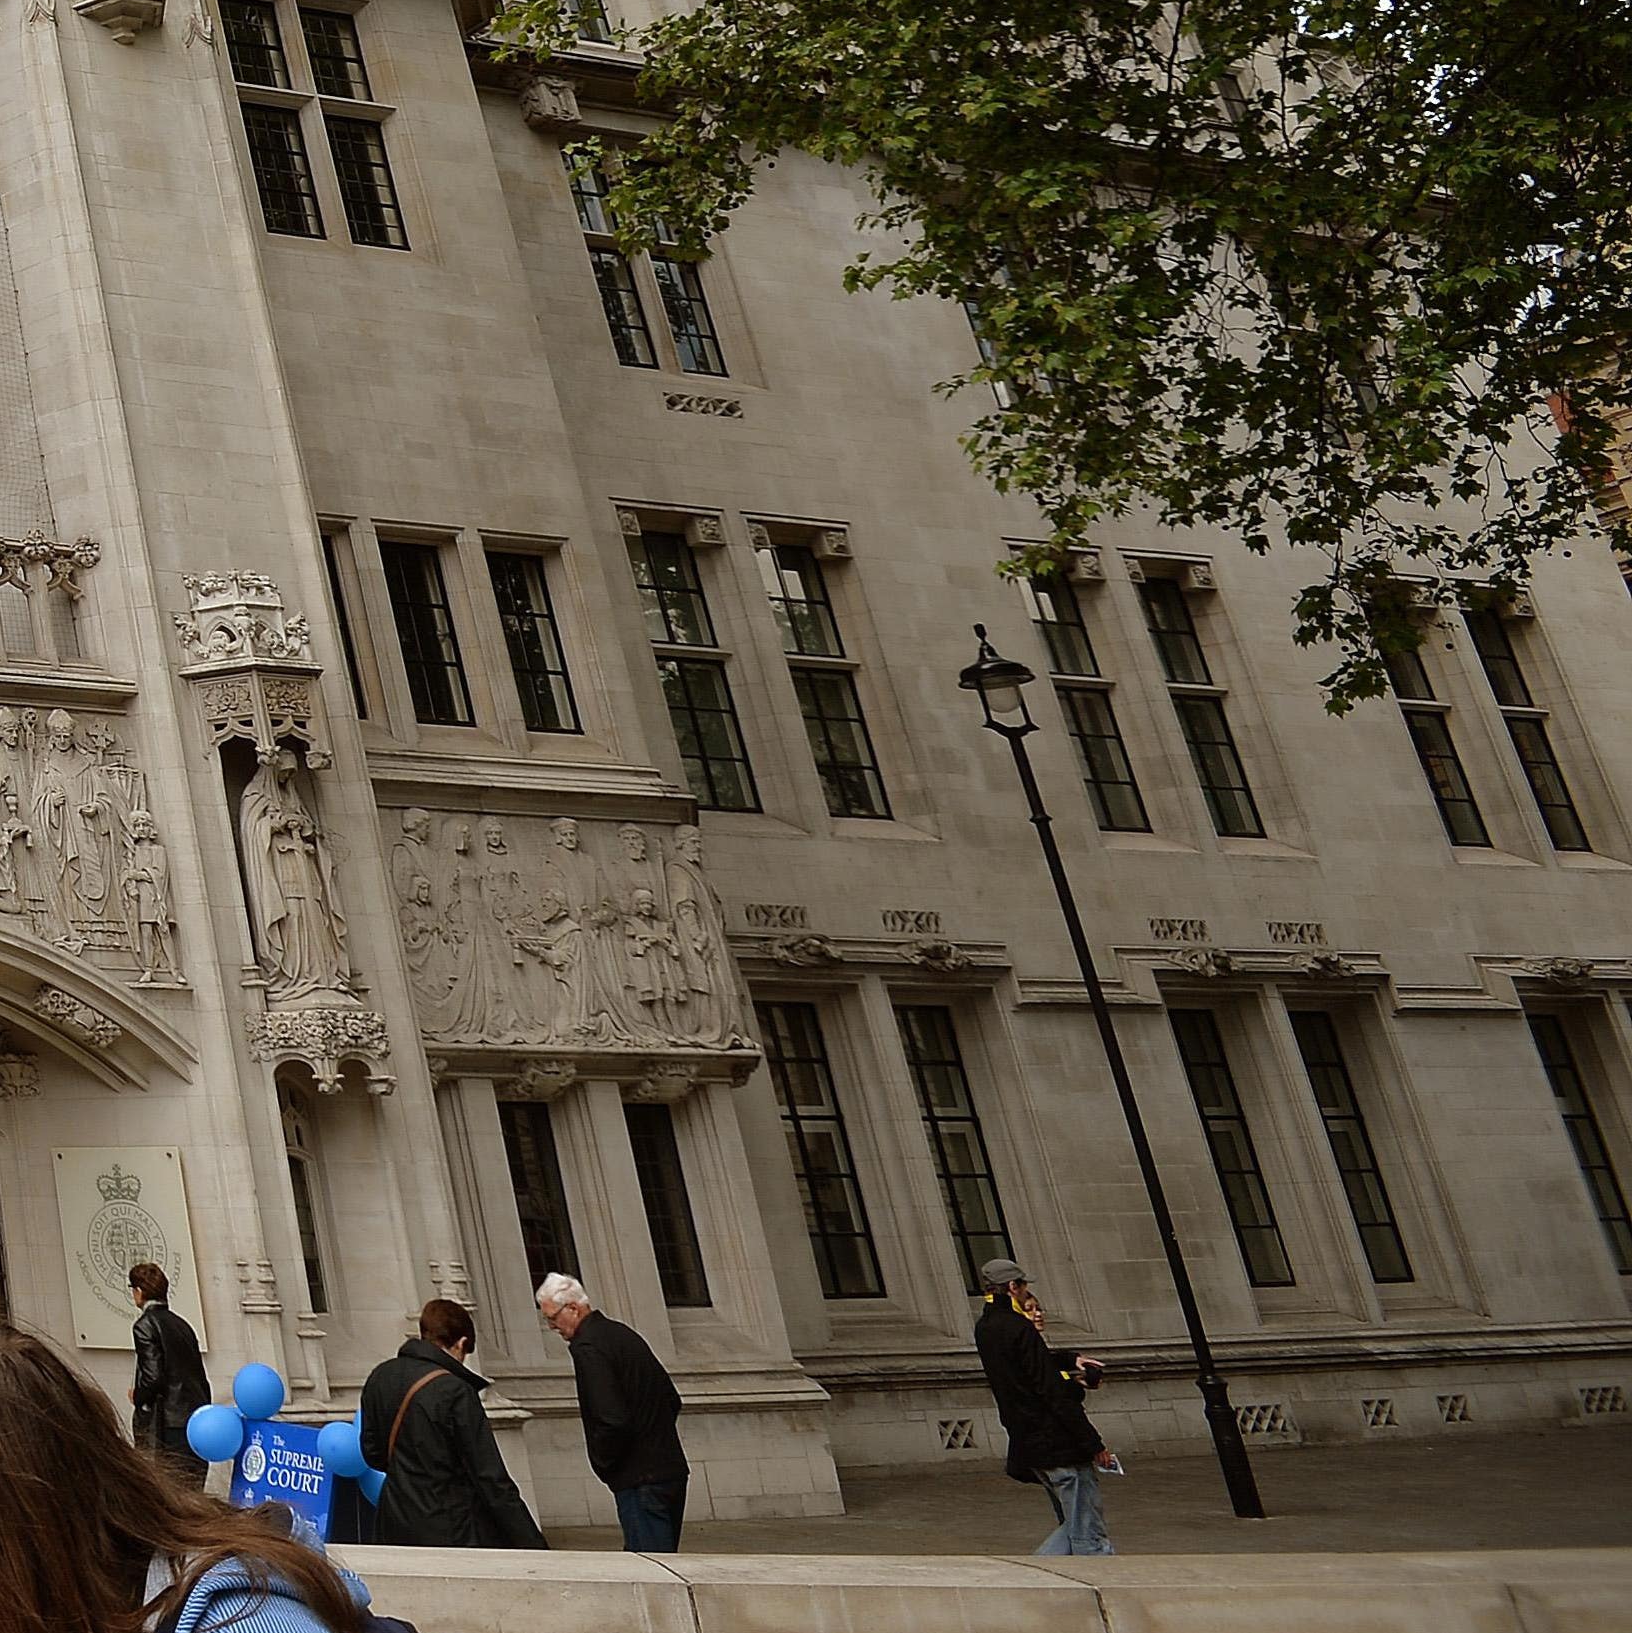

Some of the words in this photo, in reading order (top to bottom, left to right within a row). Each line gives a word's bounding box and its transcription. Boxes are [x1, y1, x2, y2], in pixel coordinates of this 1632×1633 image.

[111, 1206, 131, 1217] QUI
[272, 1434, 286, 1447] The
[268, 1448, 325, 1473] SUPREME
[267, 1466, 324, 1495] COURT
